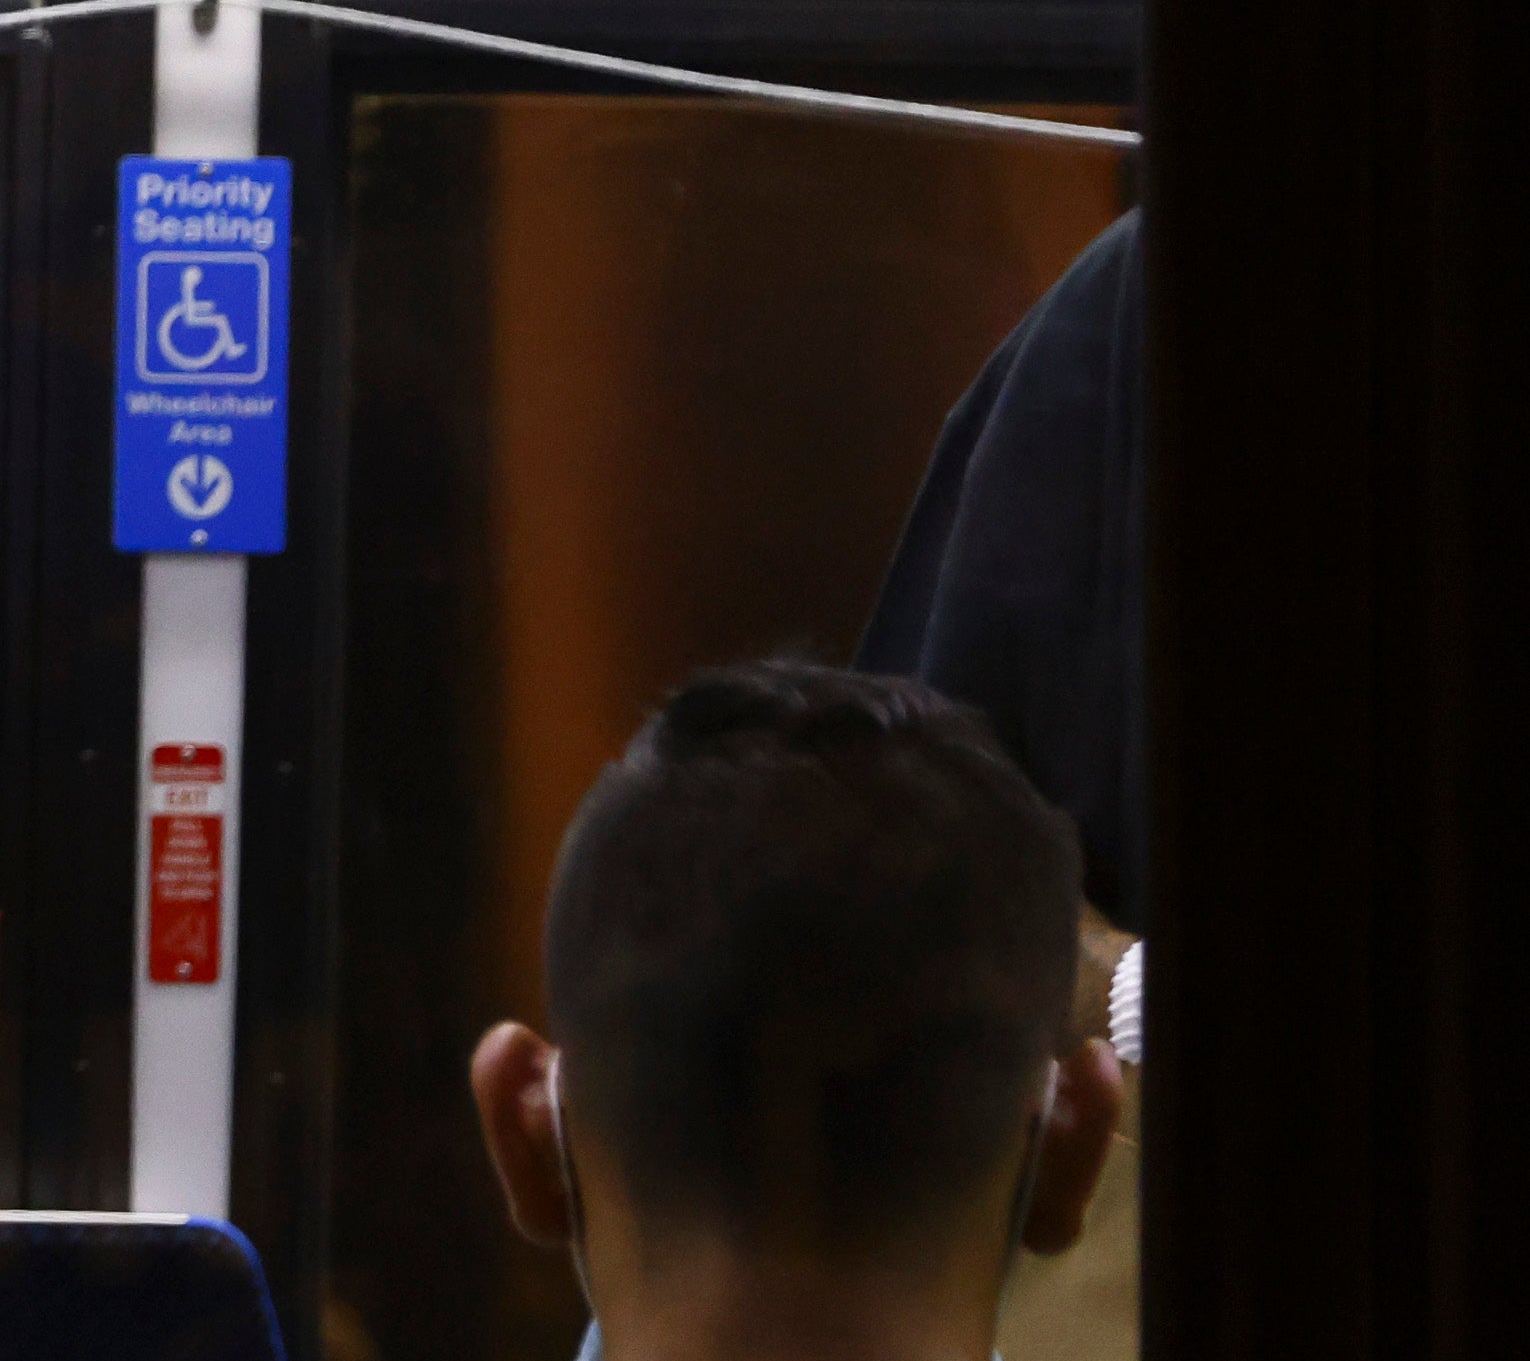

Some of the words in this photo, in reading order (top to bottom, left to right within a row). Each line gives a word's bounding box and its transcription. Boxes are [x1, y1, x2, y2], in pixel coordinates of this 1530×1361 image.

[136, 172, 274, 214] Priority
[134, 208, 275, 250] Seating
[168, 419, 234, 446] Area
